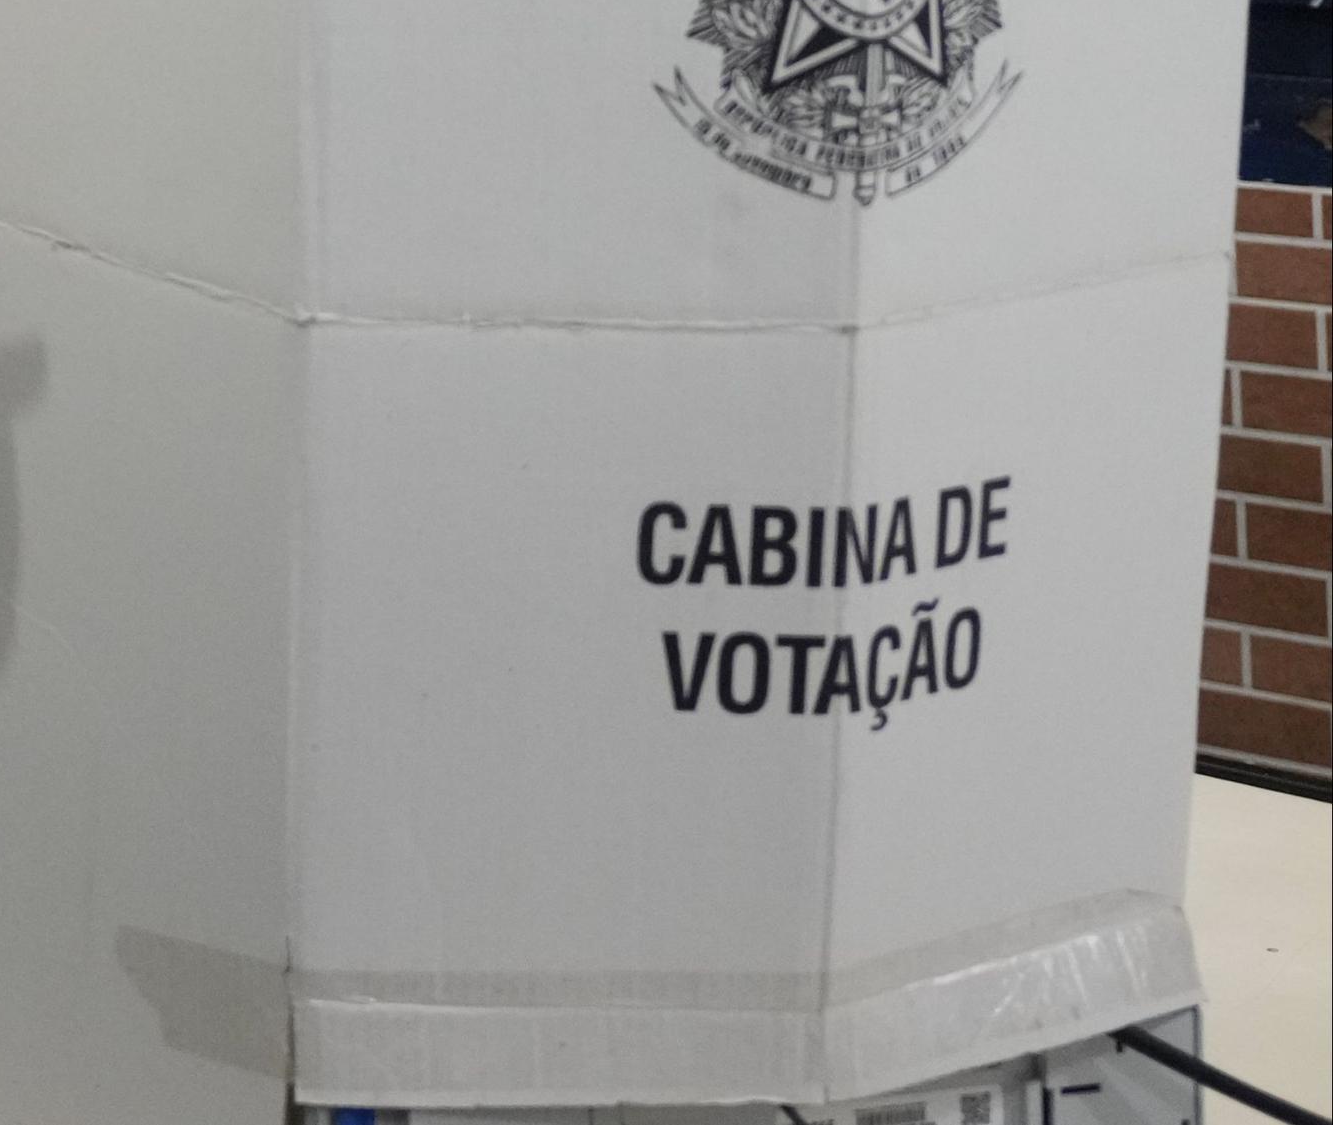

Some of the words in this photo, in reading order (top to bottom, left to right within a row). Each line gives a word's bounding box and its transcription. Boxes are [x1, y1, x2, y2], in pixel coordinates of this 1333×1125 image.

[637, 496, 918, 588] CABINA
[936, 475, 1011, 569] DE
[662, 597, 981, 731] VOTAÇÃO
